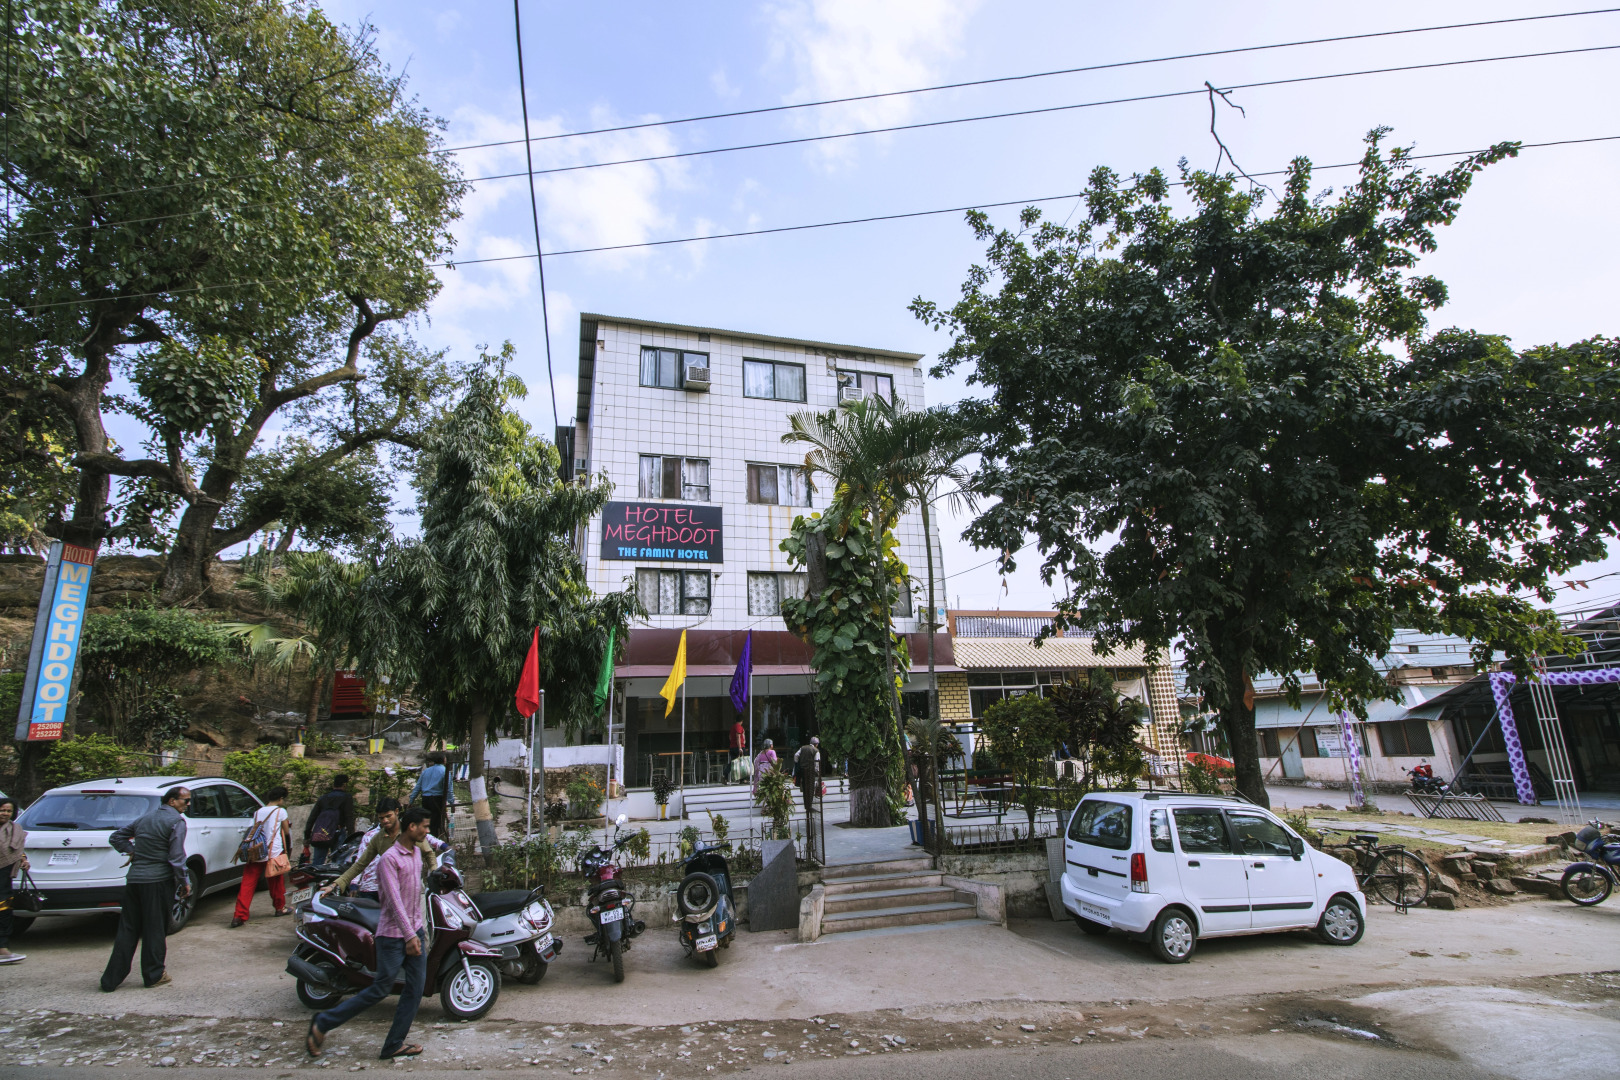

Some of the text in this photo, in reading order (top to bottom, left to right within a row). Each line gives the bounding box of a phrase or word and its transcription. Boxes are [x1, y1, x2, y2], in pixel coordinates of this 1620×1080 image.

[625, 505, 704, 525] HOTEL
[605, 524, 720, 547] MEGHDOOT
[64, 545, 93, 565] HOTEL
[617, 546, 709, 560] THE FAMILY HOTEL
[38, 563, 90, 721] MEGHDOOT
[35, 730, 61, 738] 252222
